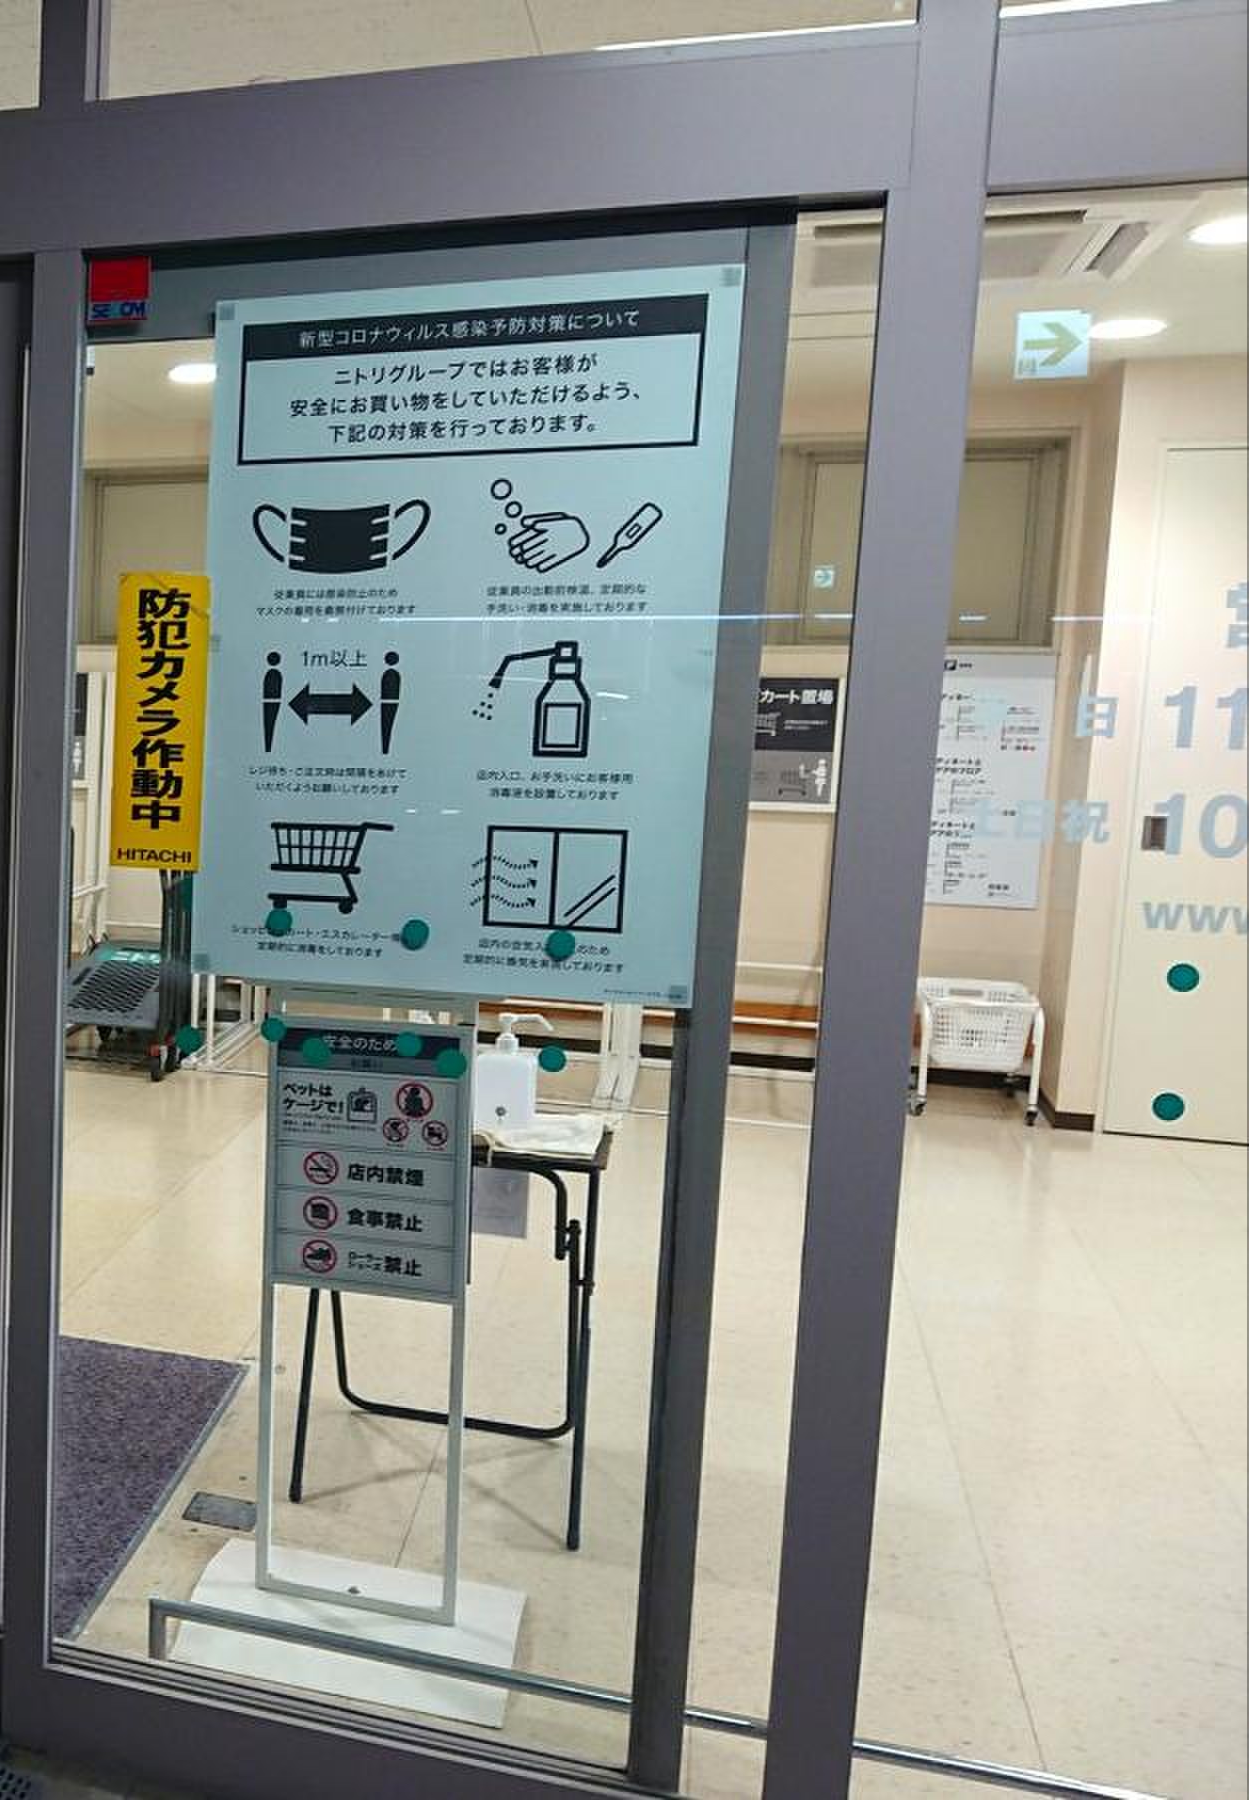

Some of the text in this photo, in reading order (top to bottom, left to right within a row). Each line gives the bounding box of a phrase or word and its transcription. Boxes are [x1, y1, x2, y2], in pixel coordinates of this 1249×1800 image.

[92, 302, 147, 319] SEOM
[299, 309, 640, 348] 新型コロナウィルス感染予防対策について
[334, 353, 597, 385] ニトリグループではお客様が
[290, 380, 640, 417] 安全にお買い物をしていただけるよう、
[328, 414, 597, 444] 下記の対策を行っております。
[301, 649, 368, 669] 1m以上
[131, 588, 191, 830] 防犯カメラ作動中
[1154, 793, 1248, 859] 10
[117, 847, 192, 863] HITACHI
[347, 1163, 424, 1187] 店内禁煙
[347, 1207, 423, 1232] 食事禁止
[384, 1255, 423, 1277] 禁止
